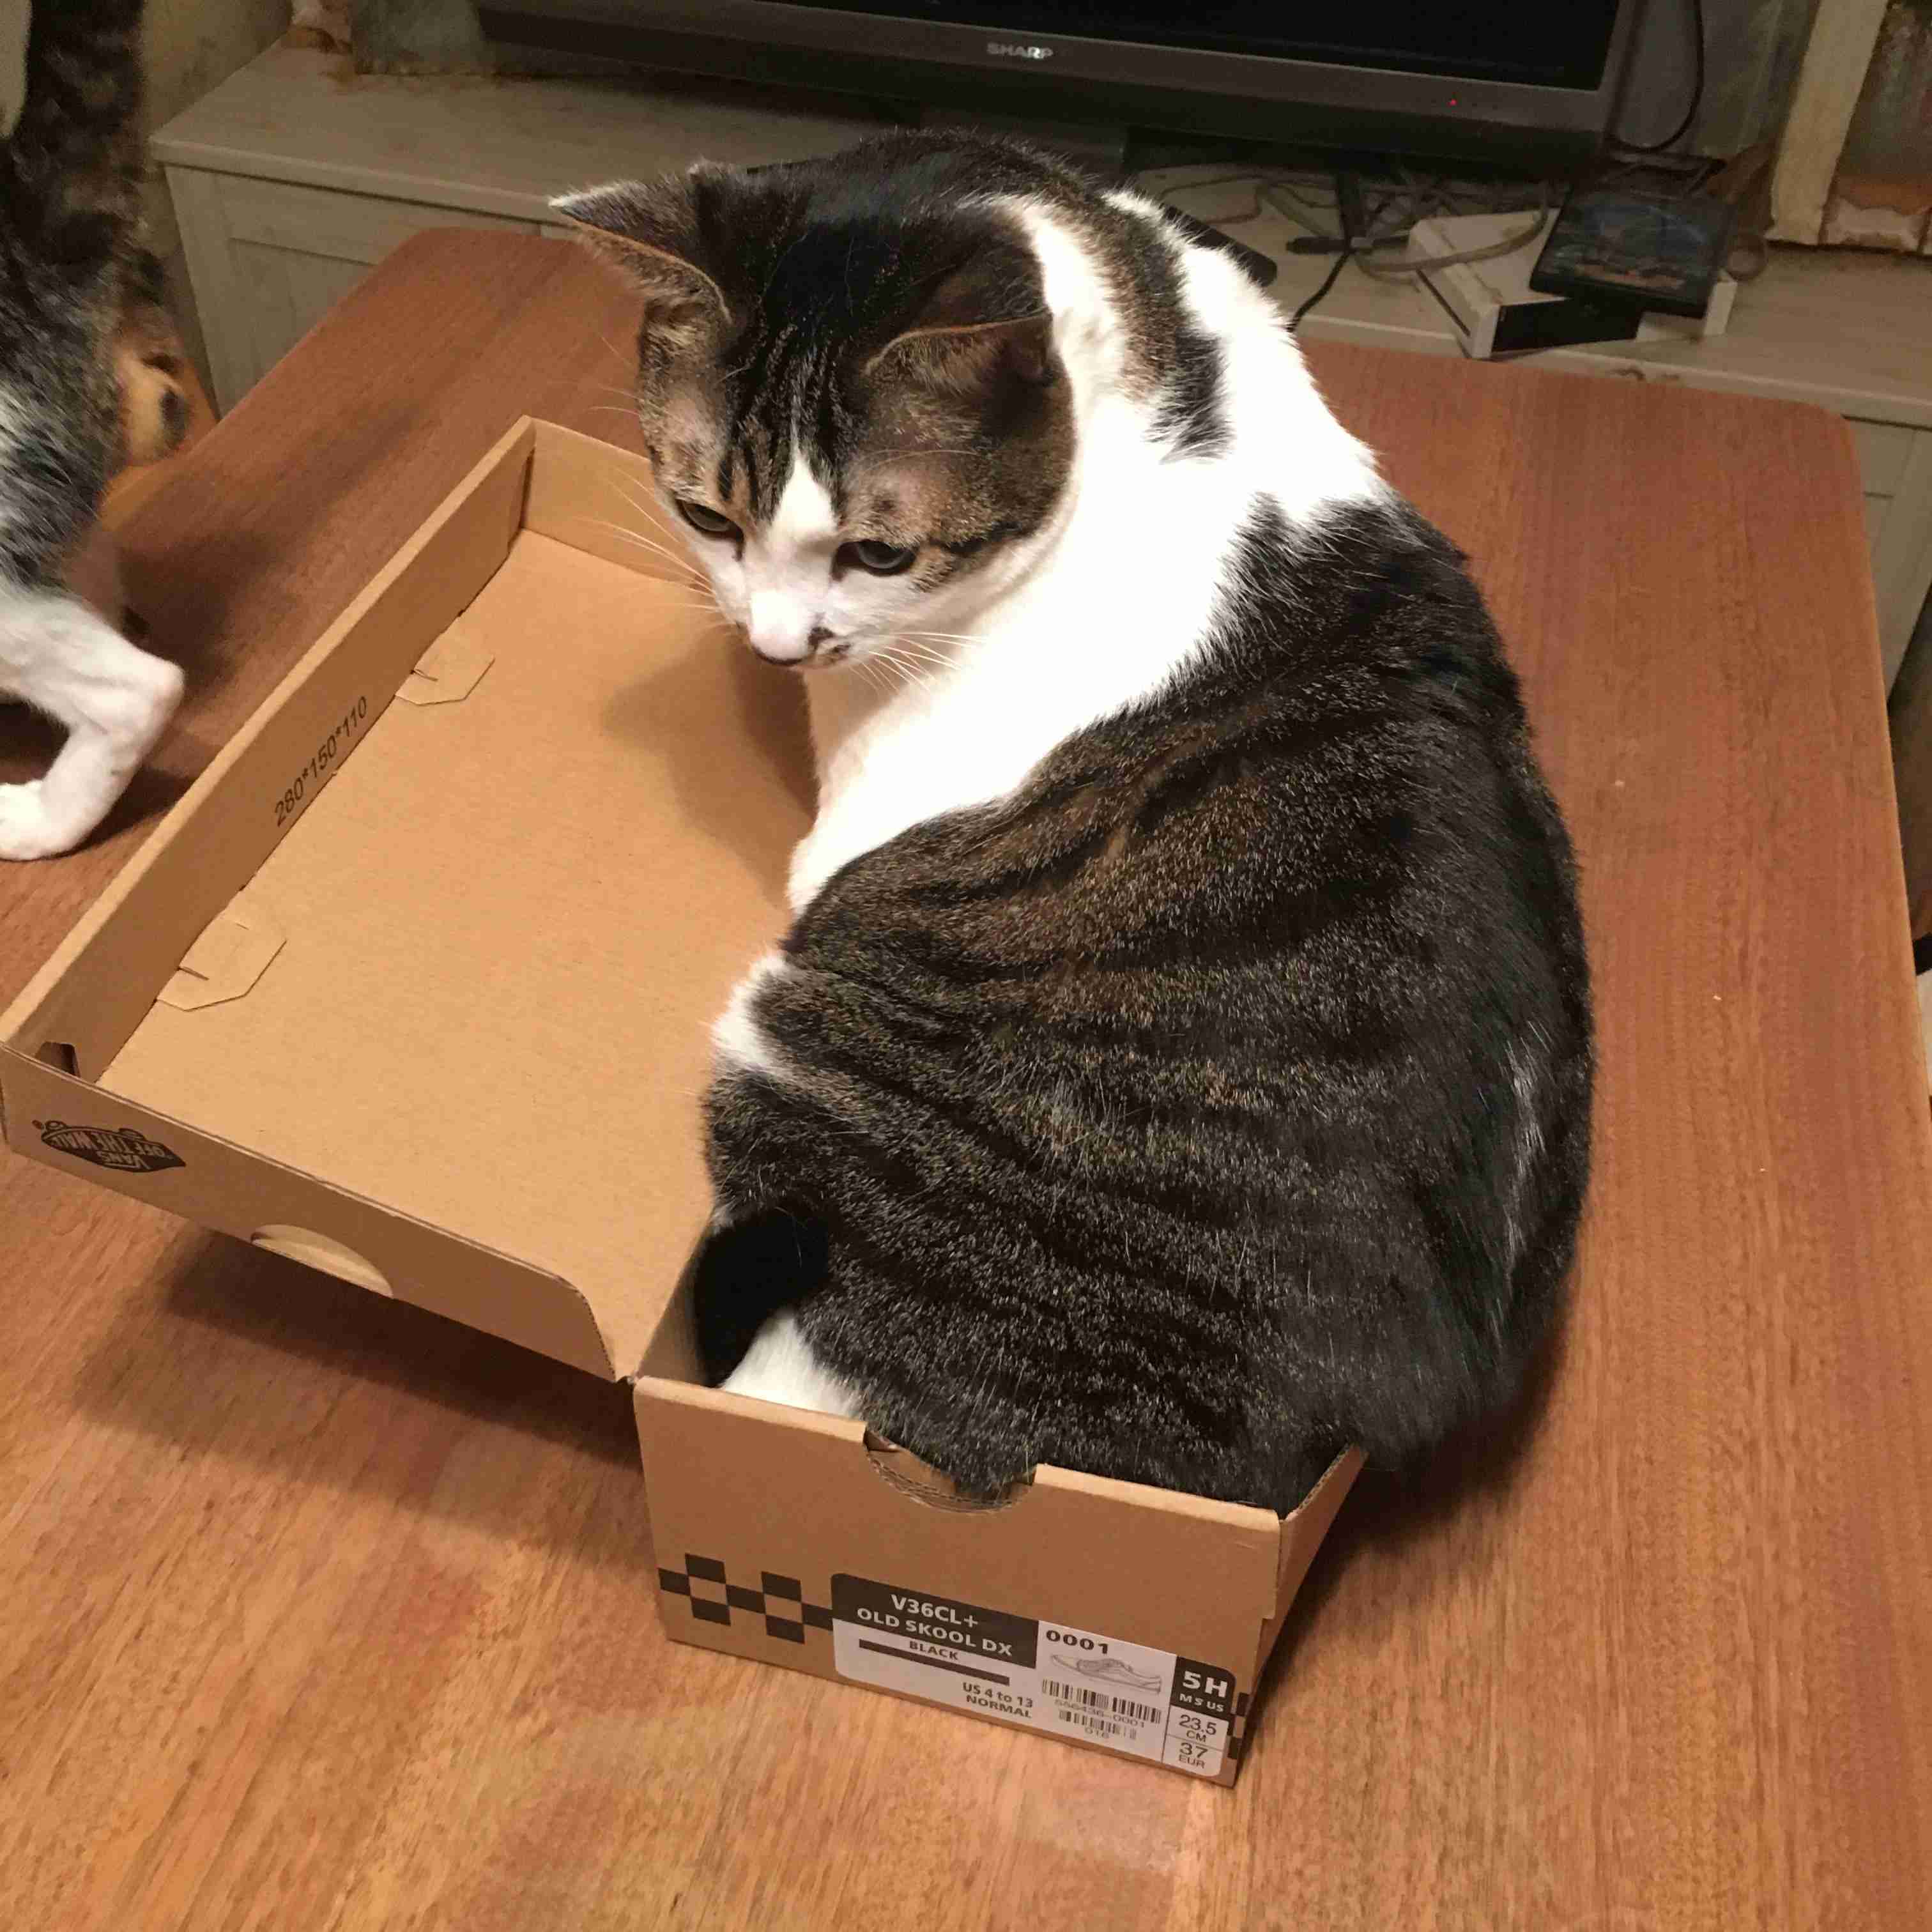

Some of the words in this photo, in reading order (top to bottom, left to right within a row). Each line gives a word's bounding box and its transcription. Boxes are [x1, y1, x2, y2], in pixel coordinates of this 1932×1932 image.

[987, 42, 1054, 59] SHARP
[97, 1150, 151, 1170] VANS
[891, 1594, 979, 1629] V36CL+
[857, 1608, 900, 1627] OLD
[905, 1620, 977, 1648] SKOOL
[982, 1638, 1013, 1657] DX
[1046, 1630, 1109, 1655] 0001
[909, 1640, 959, 1660] BLACK
[963, 1682, 981, 1695] US
[985, 1689, 993, 1698] 4
[997, 1692, 1013, 1703] to
[1017, 1696, 1033, 1708] 13
[966, 1694, 1032, 1719] NORMAL
[1206, 1701, 1225, 1712] US
[1179, 1714, 1217, 1735] 23.5
[1186, 1729, 1207, 1743] CM
[1179, 1742, 1208, 1759] 37
[1179, 1755, 1206, 1769] EUR
